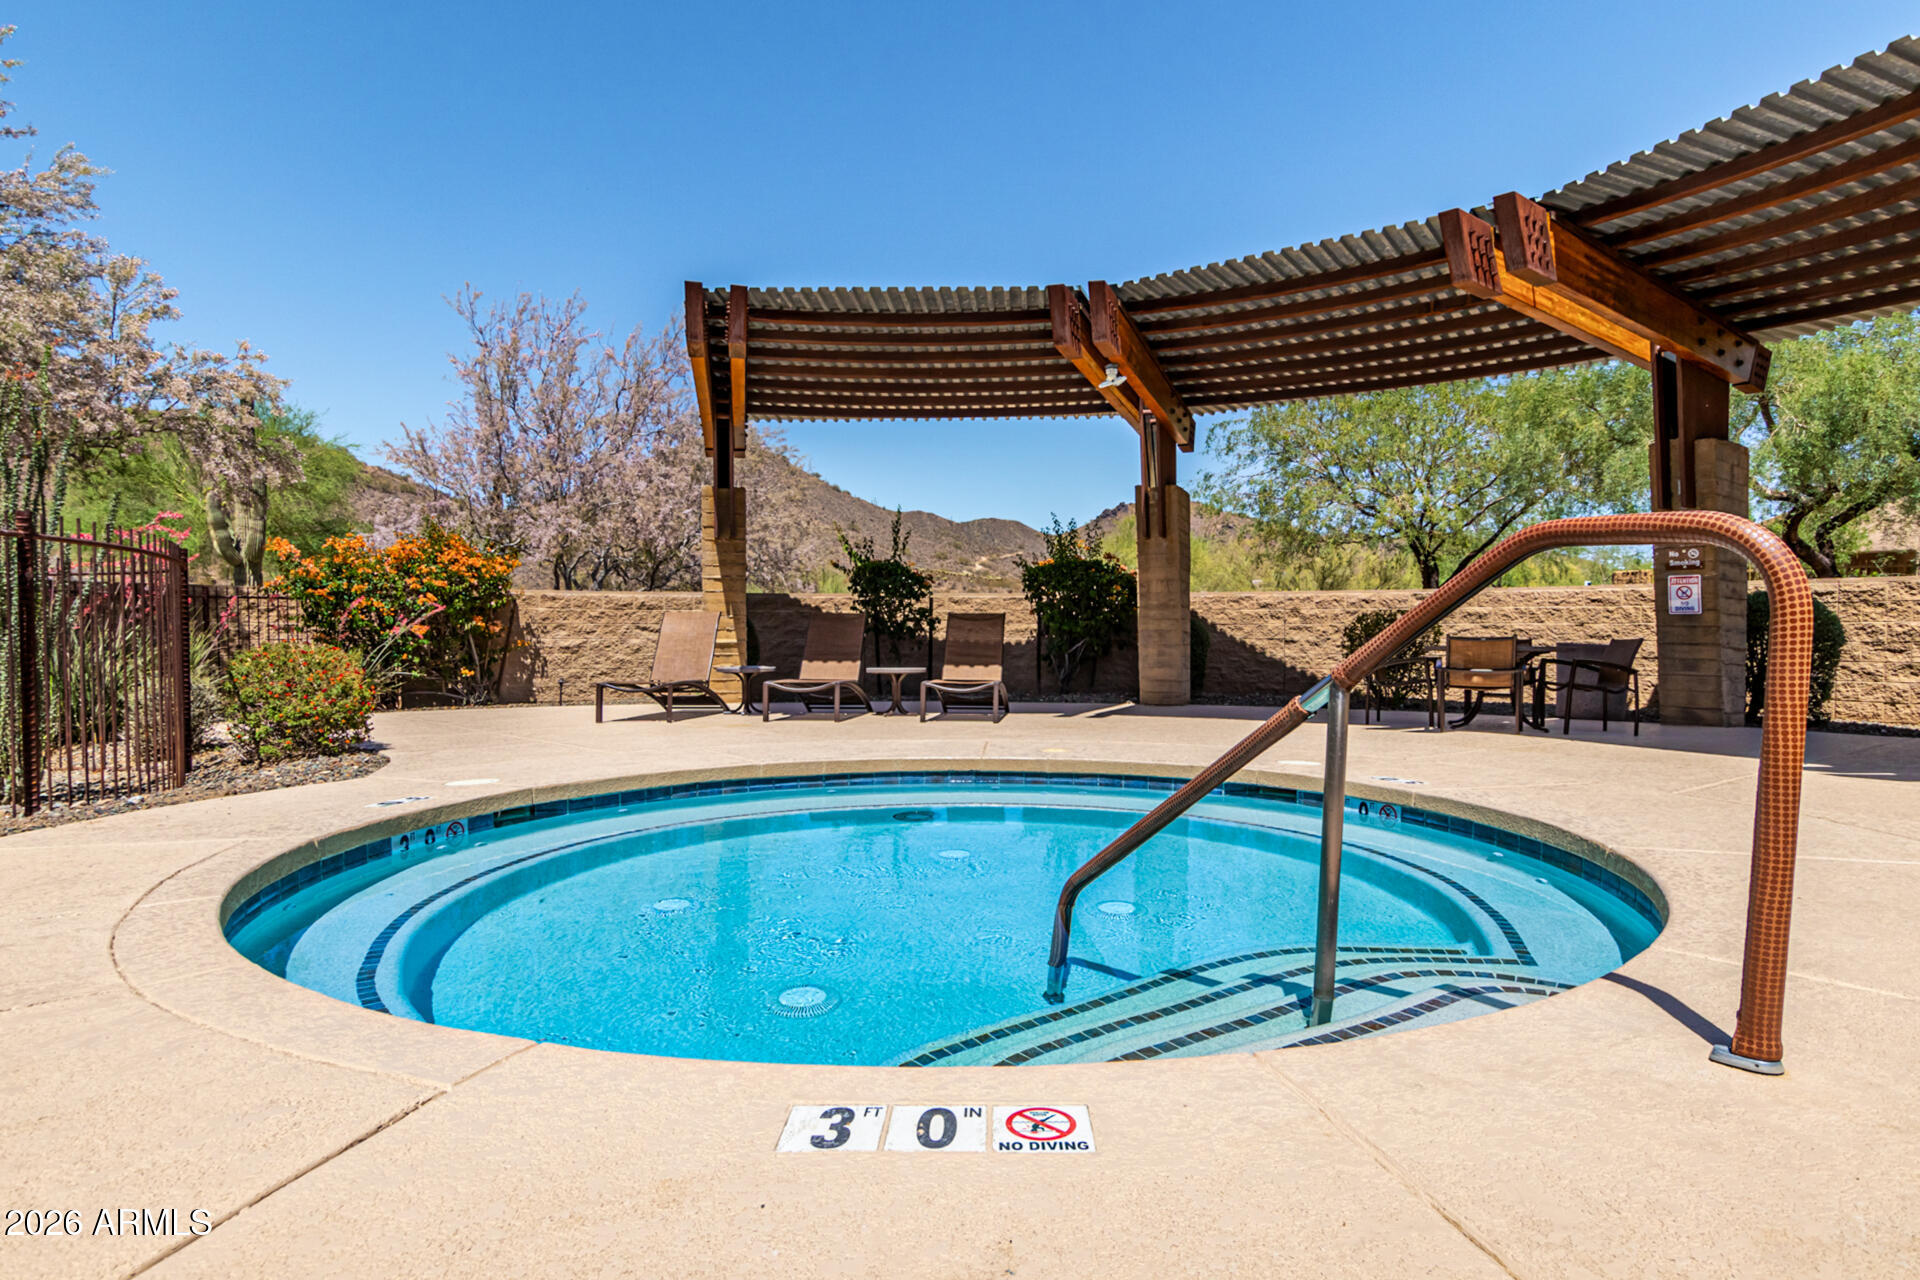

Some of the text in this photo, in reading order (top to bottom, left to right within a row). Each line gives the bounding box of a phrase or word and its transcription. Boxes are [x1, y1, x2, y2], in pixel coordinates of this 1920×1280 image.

[1669, 559, 1700, 567] Smoking
[809, 1106, 983, 1149] 3 FT 0 IN
[998, 1141, 1090, 1151] NO DIVING
